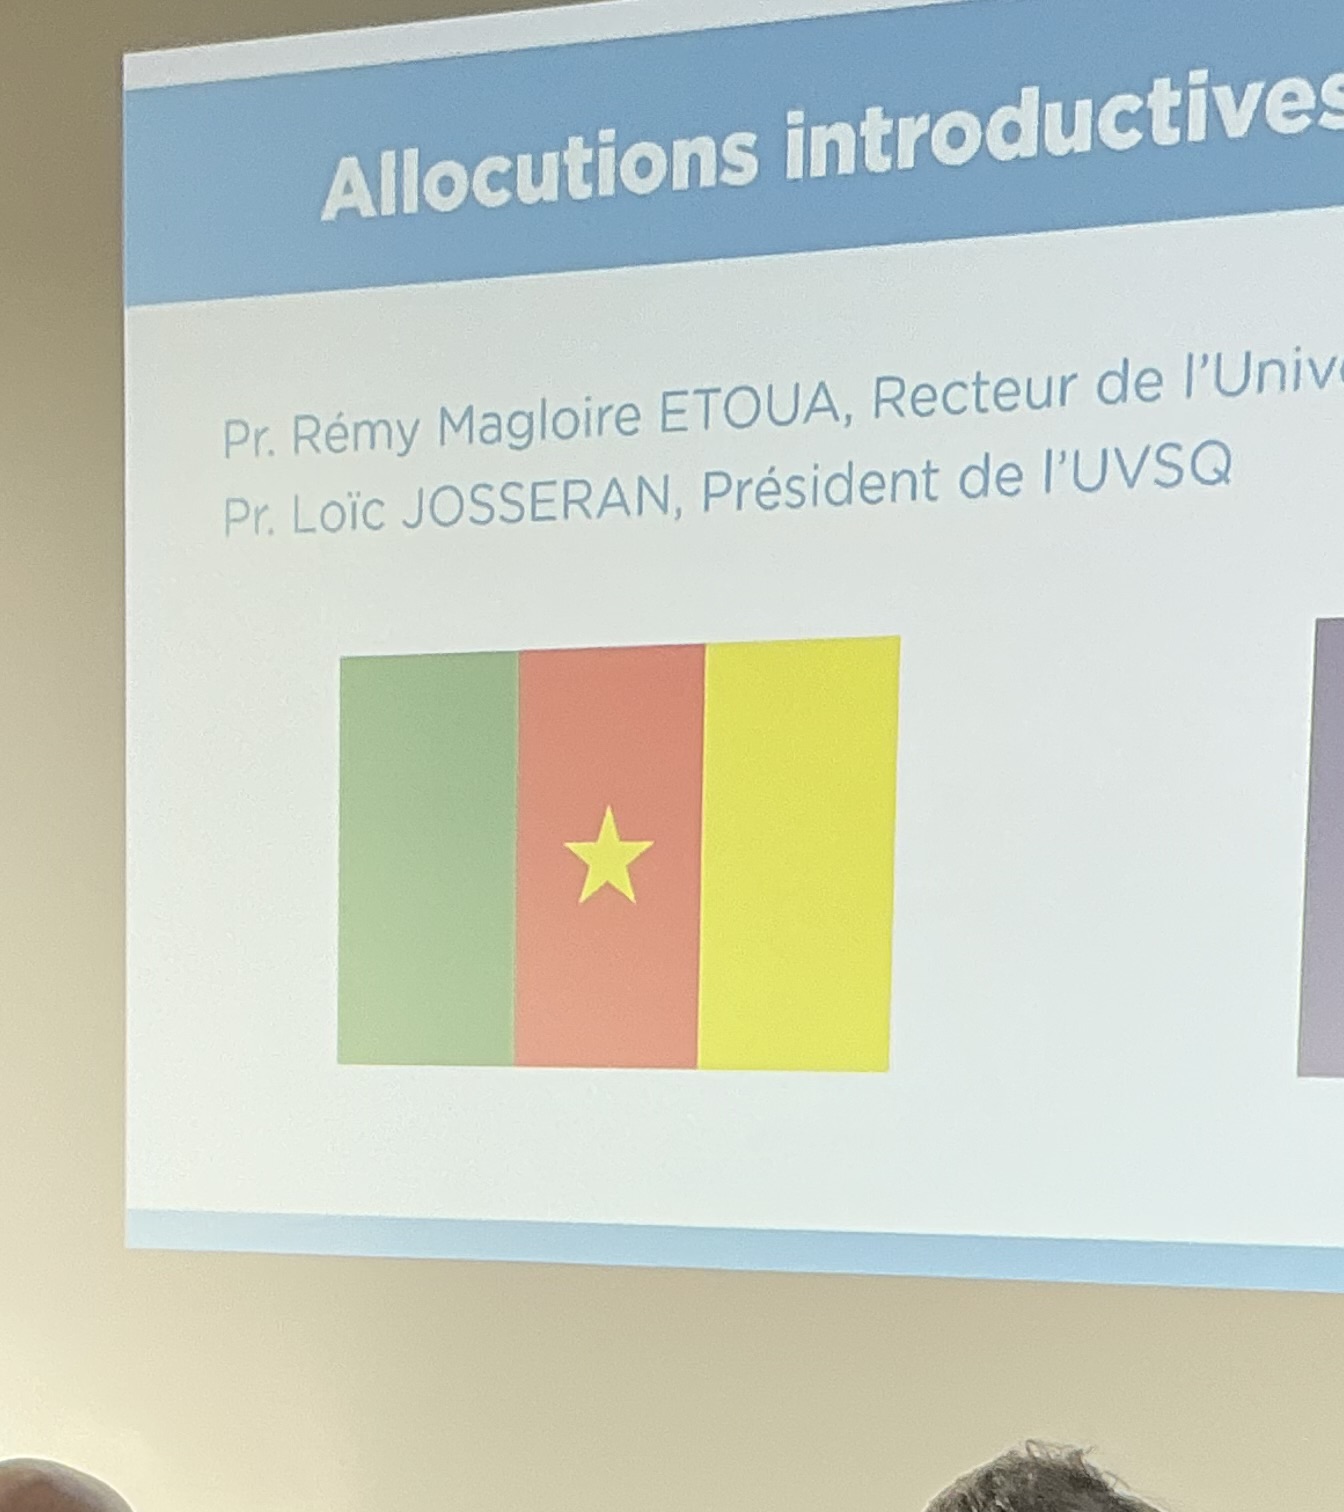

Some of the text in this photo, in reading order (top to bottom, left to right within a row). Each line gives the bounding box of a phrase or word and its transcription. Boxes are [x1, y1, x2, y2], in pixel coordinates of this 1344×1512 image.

[320, 128, 759, 222] Allocutions
[224, 418, 275, 460] Pr.
[293, 410, 421, 458] Rémy
[439, 395, 641, 452] Magloire
[661, 380, 852, 433] ETOUA,
[874, 370, 1079, 419] Recteur
[1096, 356, 1163, 405] de
[224, 439, 1232, 538] Pr. Loïc JOSSERAN, Président de l’UVSQ
